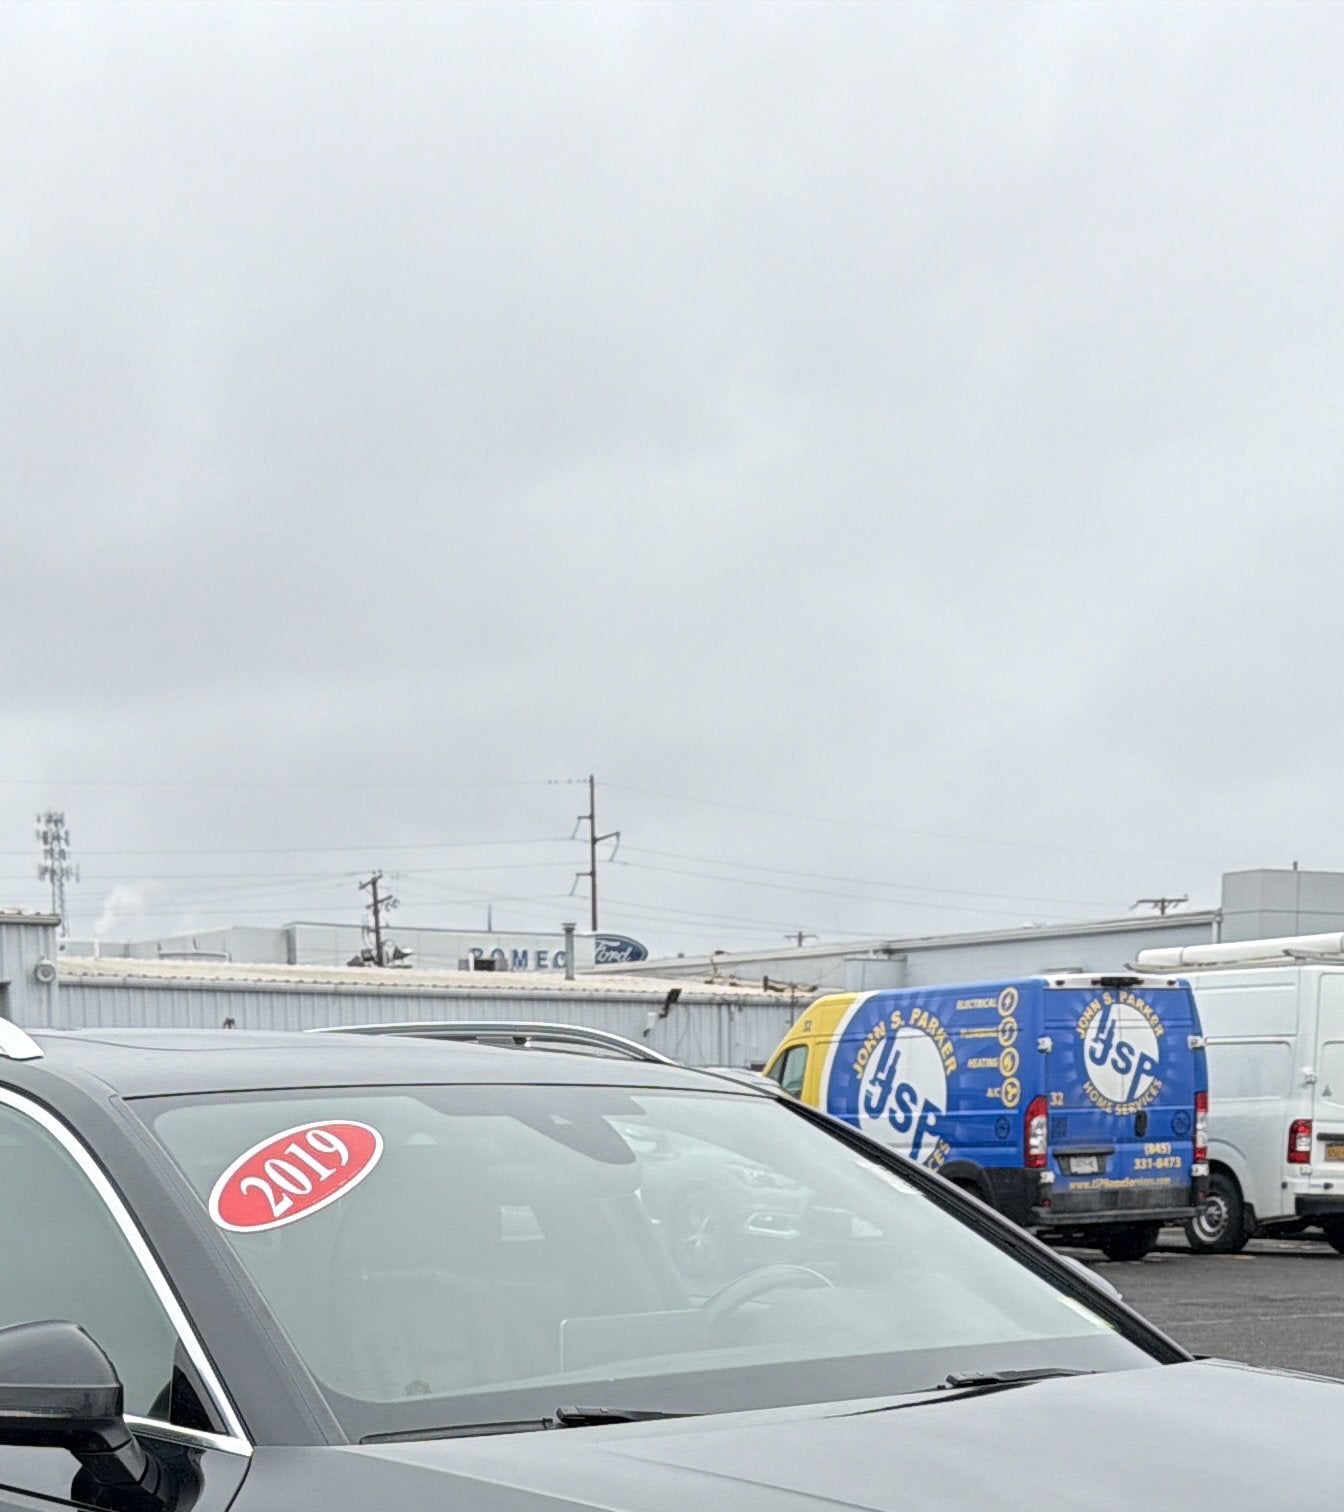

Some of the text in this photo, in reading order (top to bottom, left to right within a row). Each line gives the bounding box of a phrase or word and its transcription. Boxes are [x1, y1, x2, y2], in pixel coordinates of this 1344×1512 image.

[595, 940, 633, 962] Ford
[853, 1008, 957, 1079] JOHN S. PARKER
[1076, 991, 1165, 1039] JOHN S. PARKER
[1089, 1006, 1159, 1101] JSP
[864, 1037, 945, 1160] JSP
[240, 1129, 349, 1218] 2019
